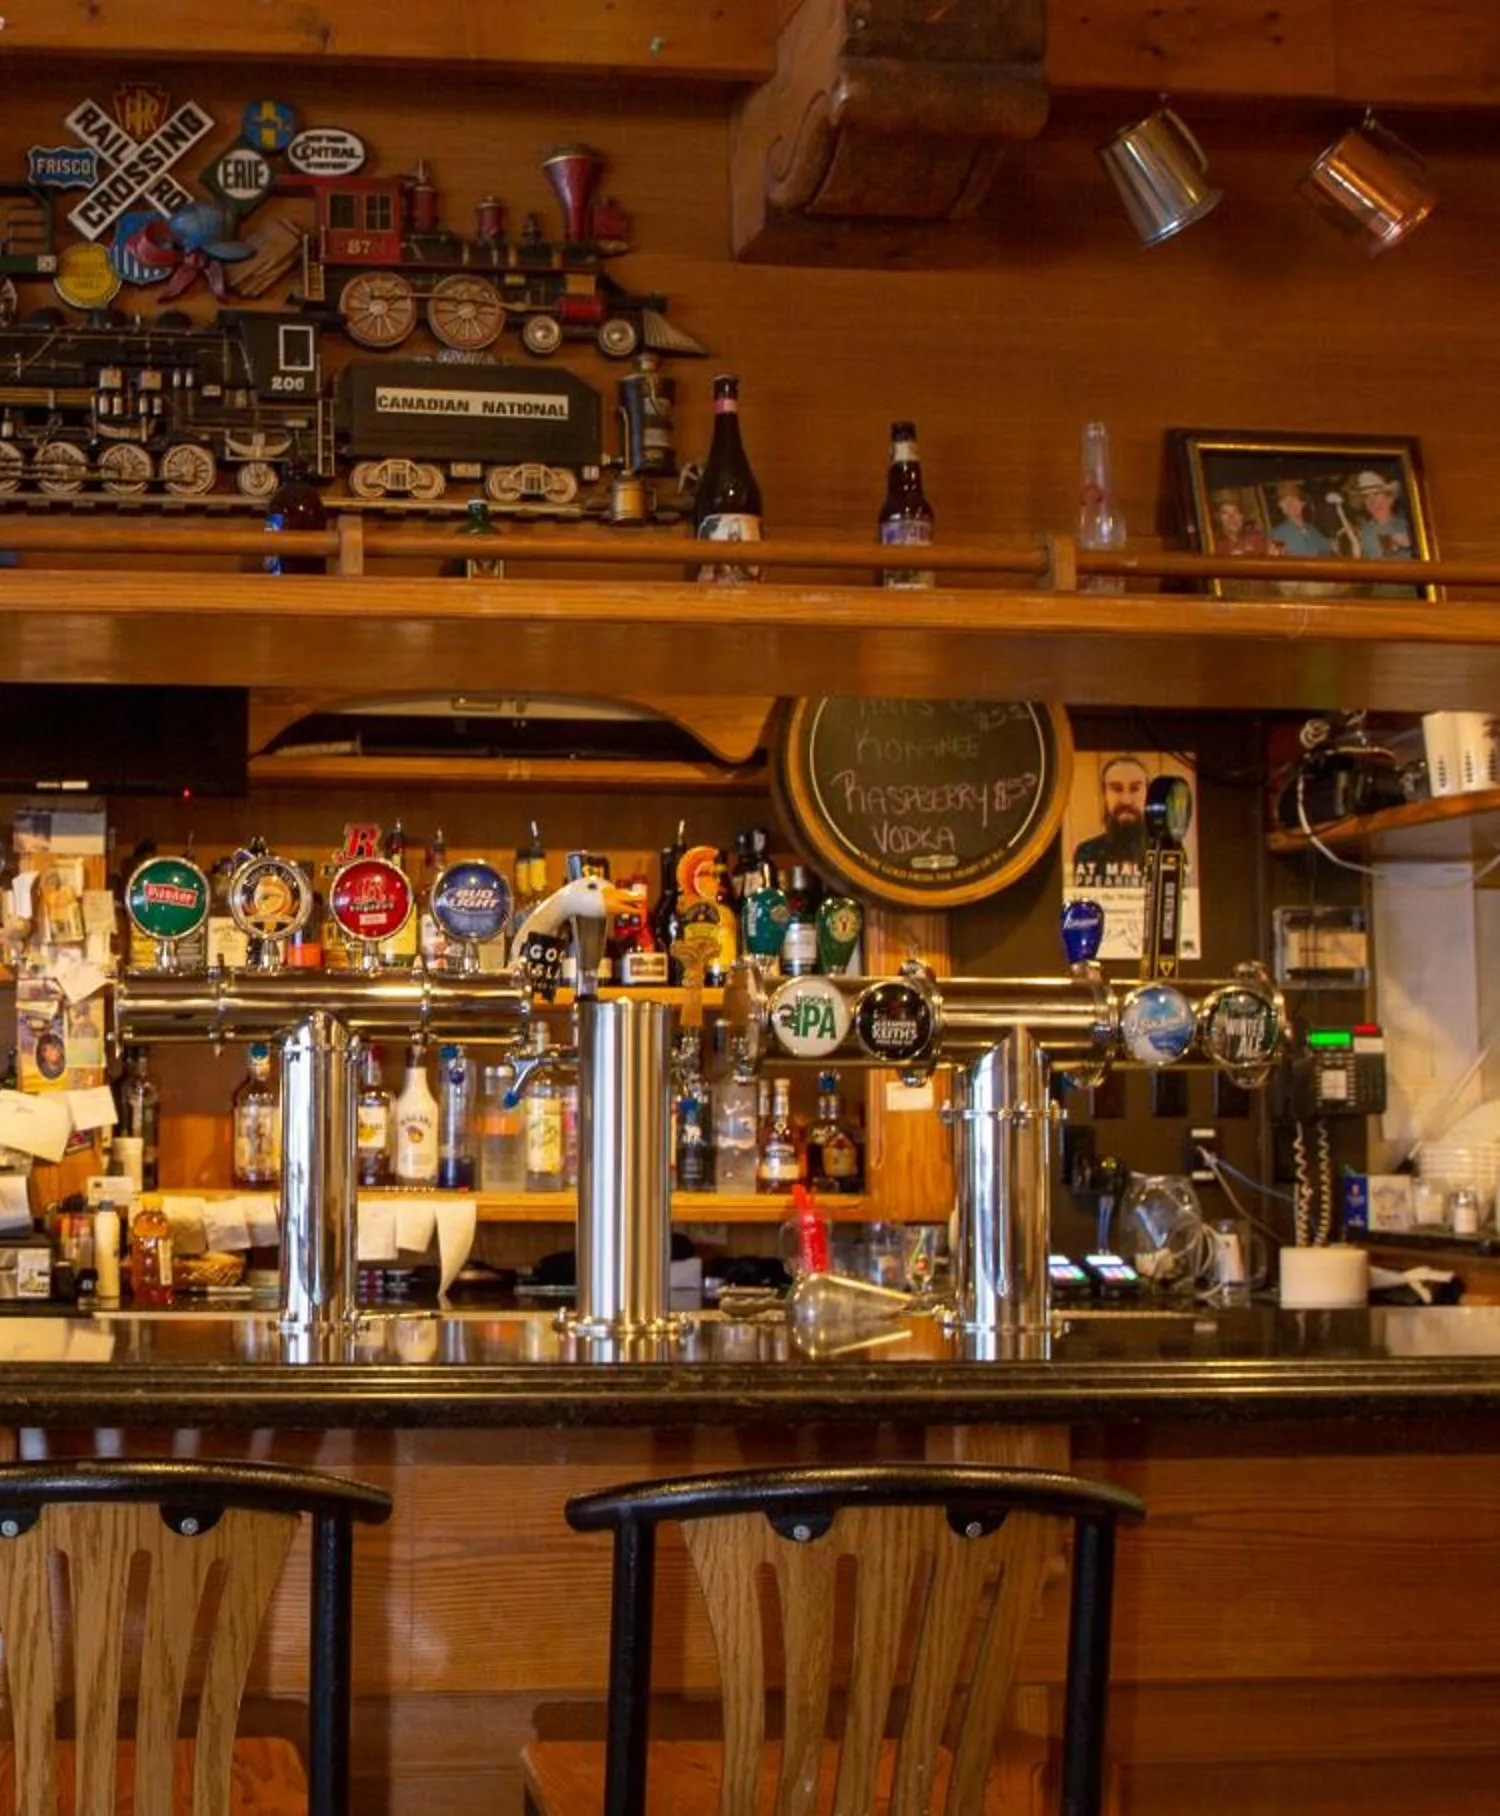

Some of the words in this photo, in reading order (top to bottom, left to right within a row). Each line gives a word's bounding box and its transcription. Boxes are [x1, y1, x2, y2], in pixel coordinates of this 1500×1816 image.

[75, 107, 131, 167] RAIL
[291, 140, 362, 161] CENTRAL
[37, 156, 92, 176] FRISCO
[77, 107, 206, 229] CROSSING
[222, 159, 267, 190] ERIE
[377, 394, 470, 413] CANADIAN
[482, 401, 569, 418] NATIONAL
[871, 818, 957, 855] VODKA
[450, 898, 500, 910] LIGHT
[455, 888, 494, 899] BUD
[792, 1002, 838, 1040] IPA
